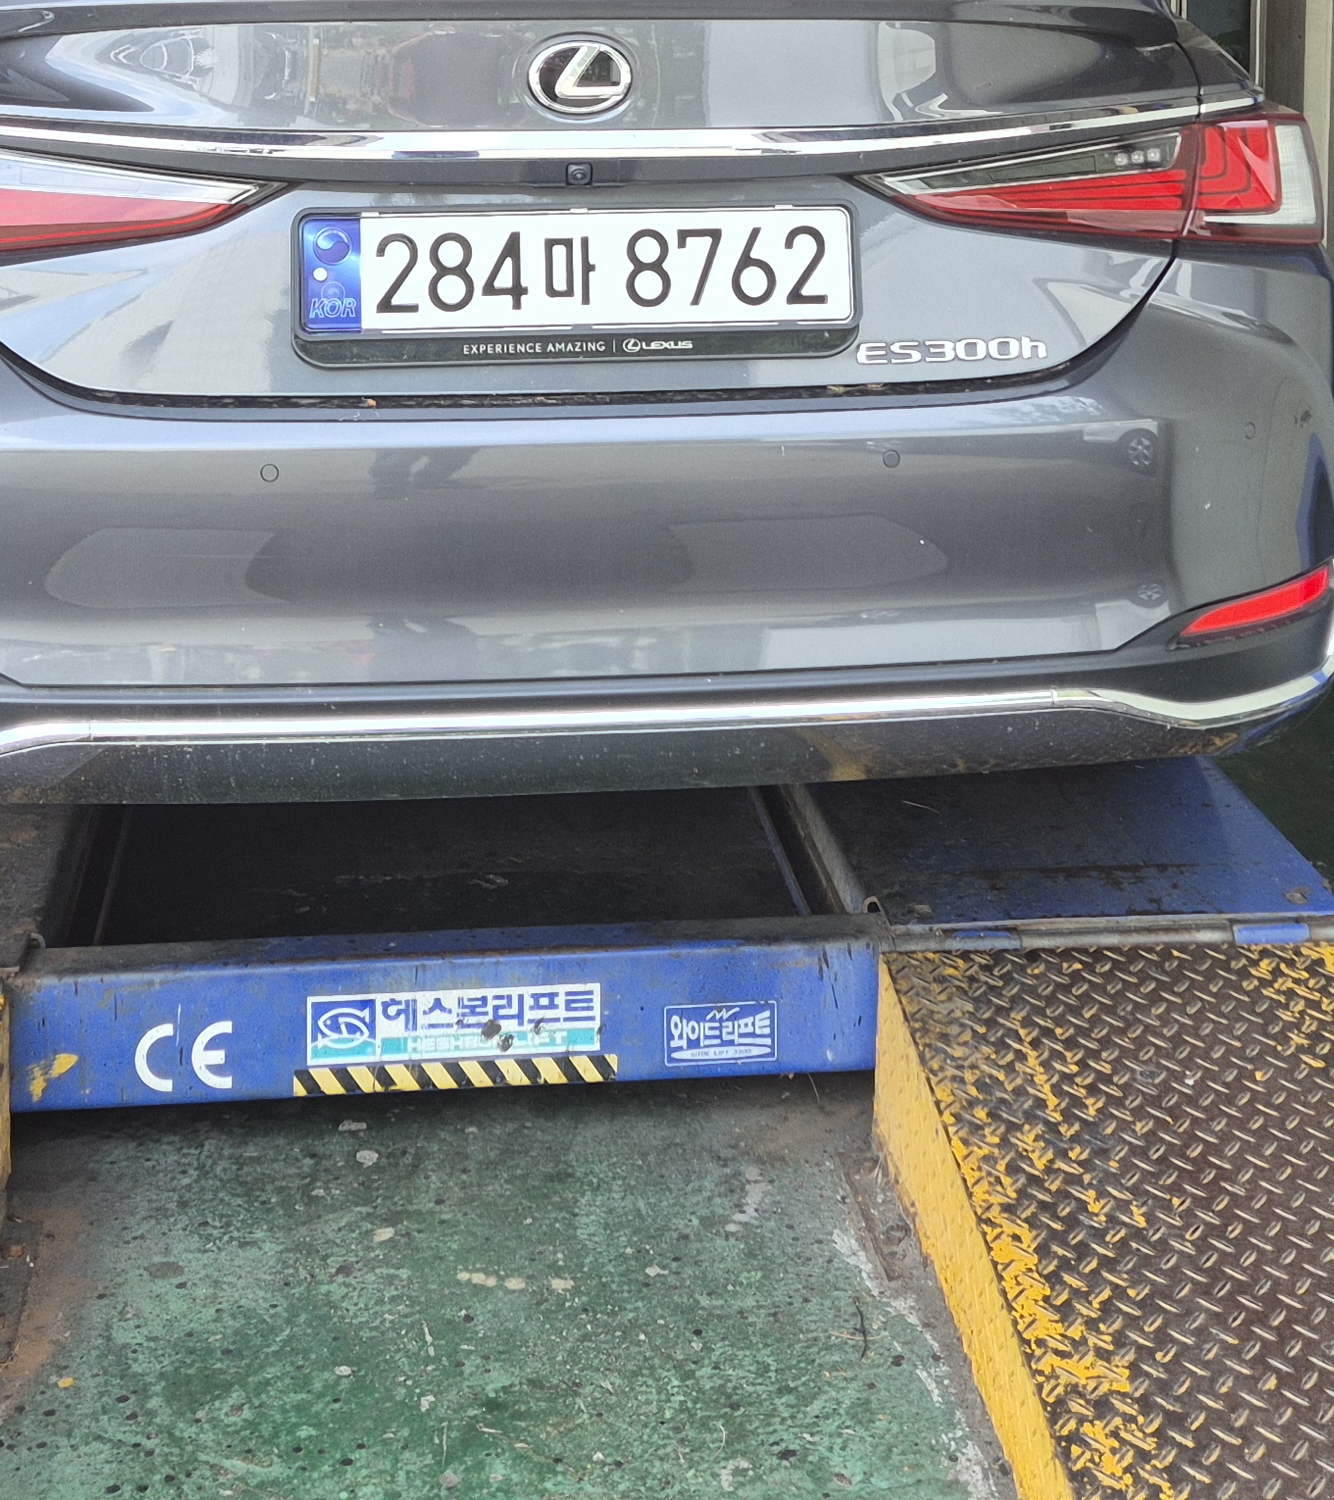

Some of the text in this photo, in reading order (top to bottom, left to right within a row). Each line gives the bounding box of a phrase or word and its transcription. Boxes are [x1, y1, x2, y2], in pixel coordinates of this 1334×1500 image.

[374, 224, 830, 315] 284마 8762
[309, 297, 357, 319] KOR
[463, 340, 694, 355] EXPERIENCE AMAZING LEXUS
[855, 338, 1049, 367] ES300h
[380, 990, 597, 1032] 헤스본리프트
[669, 1010, 772, 1049] 와이드리프트
[133, 1020, 234, 1093] CE
